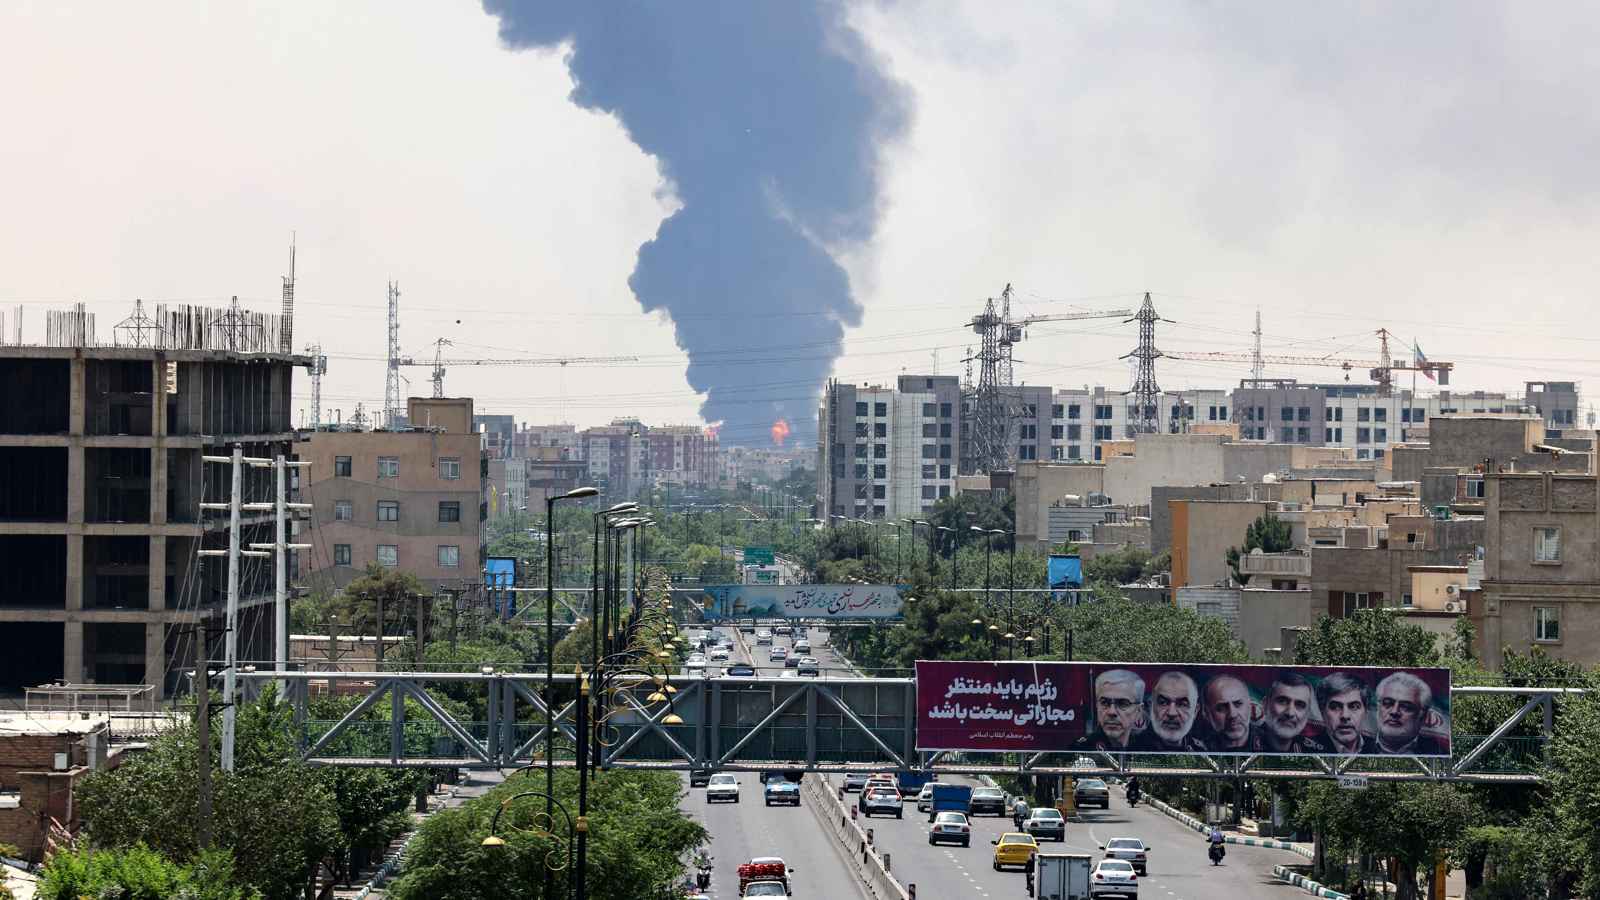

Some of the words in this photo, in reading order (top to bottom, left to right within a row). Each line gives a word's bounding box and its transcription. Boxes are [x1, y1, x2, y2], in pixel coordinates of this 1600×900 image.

[945, 677, 993, 698] منتظر
[993, 678, 1023, 699] باید
[1025, 677, 1057, 700] رژیم
[928, 701, 967, 724] باشد
[969, 703, 1014, 719] سخت
[1014, 704, 1075, 726] مجازاتی
